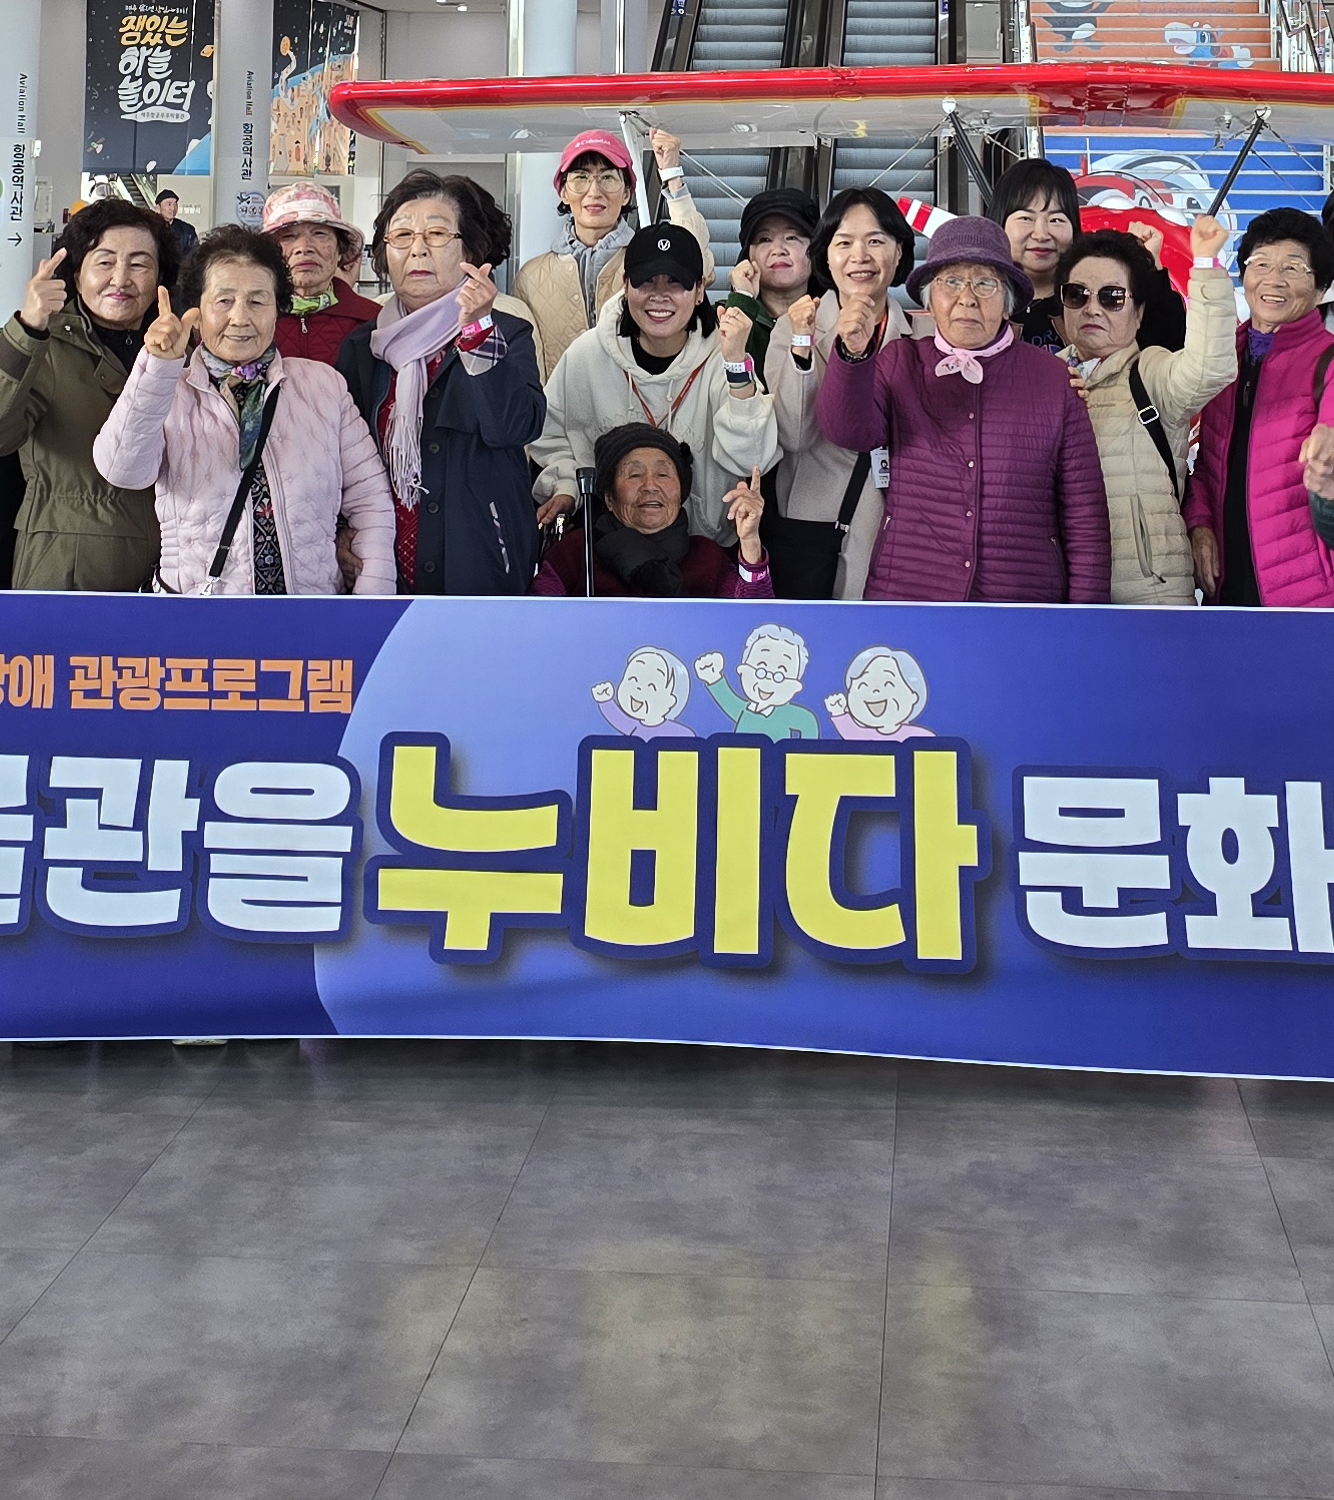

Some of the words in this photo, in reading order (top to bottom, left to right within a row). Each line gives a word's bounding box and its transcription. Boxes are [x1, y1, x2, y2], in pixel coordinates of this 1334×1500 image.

[119, 14, 188, 47] 잼있는
[118, 46, 173, 80] 하늘
[18, 73, 28, 112] Aviation
[117, 75, 196, 113] 놀이터
[246, 70, 255, 100] Aviation
[17, 114, 26, 134] Hall
[241, 123, 254, 180] 항공역사관
[10, 144, 26, 221] 항공역사관
[69, 654, 354, 716] 관광프로그램
[377, 746, 978, 962] 누비다
